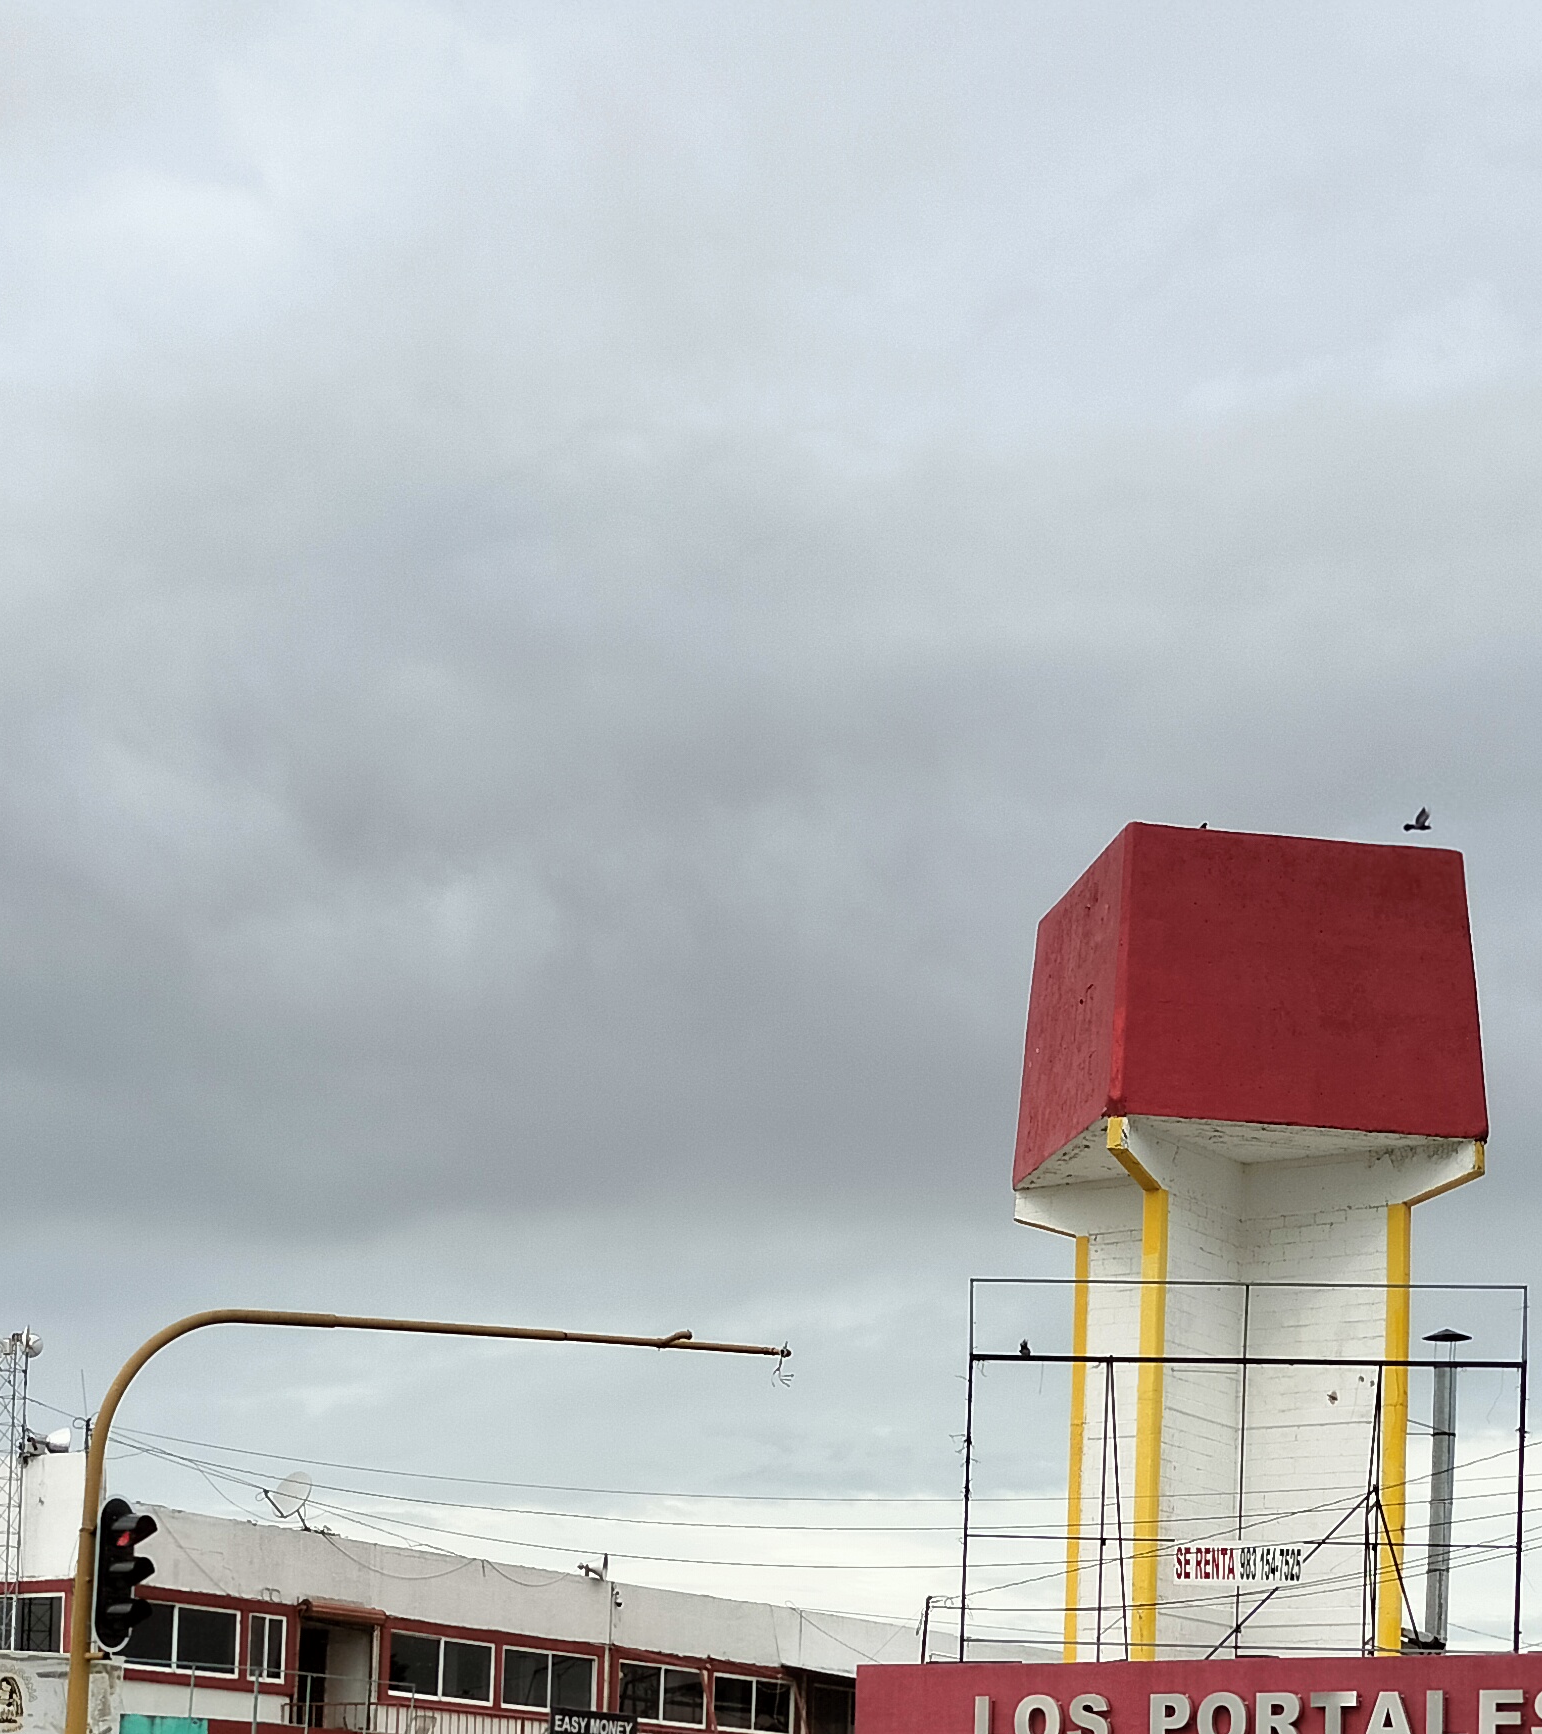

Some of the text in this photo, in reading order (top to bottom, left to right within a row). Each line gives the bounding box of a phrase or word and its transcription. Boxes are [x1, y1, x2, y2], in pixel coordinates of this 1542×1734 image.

[1176, 1547, 1301, 1581] SE RENTA 983 154-7525
[554, 1715, 588, 1734] EASY
